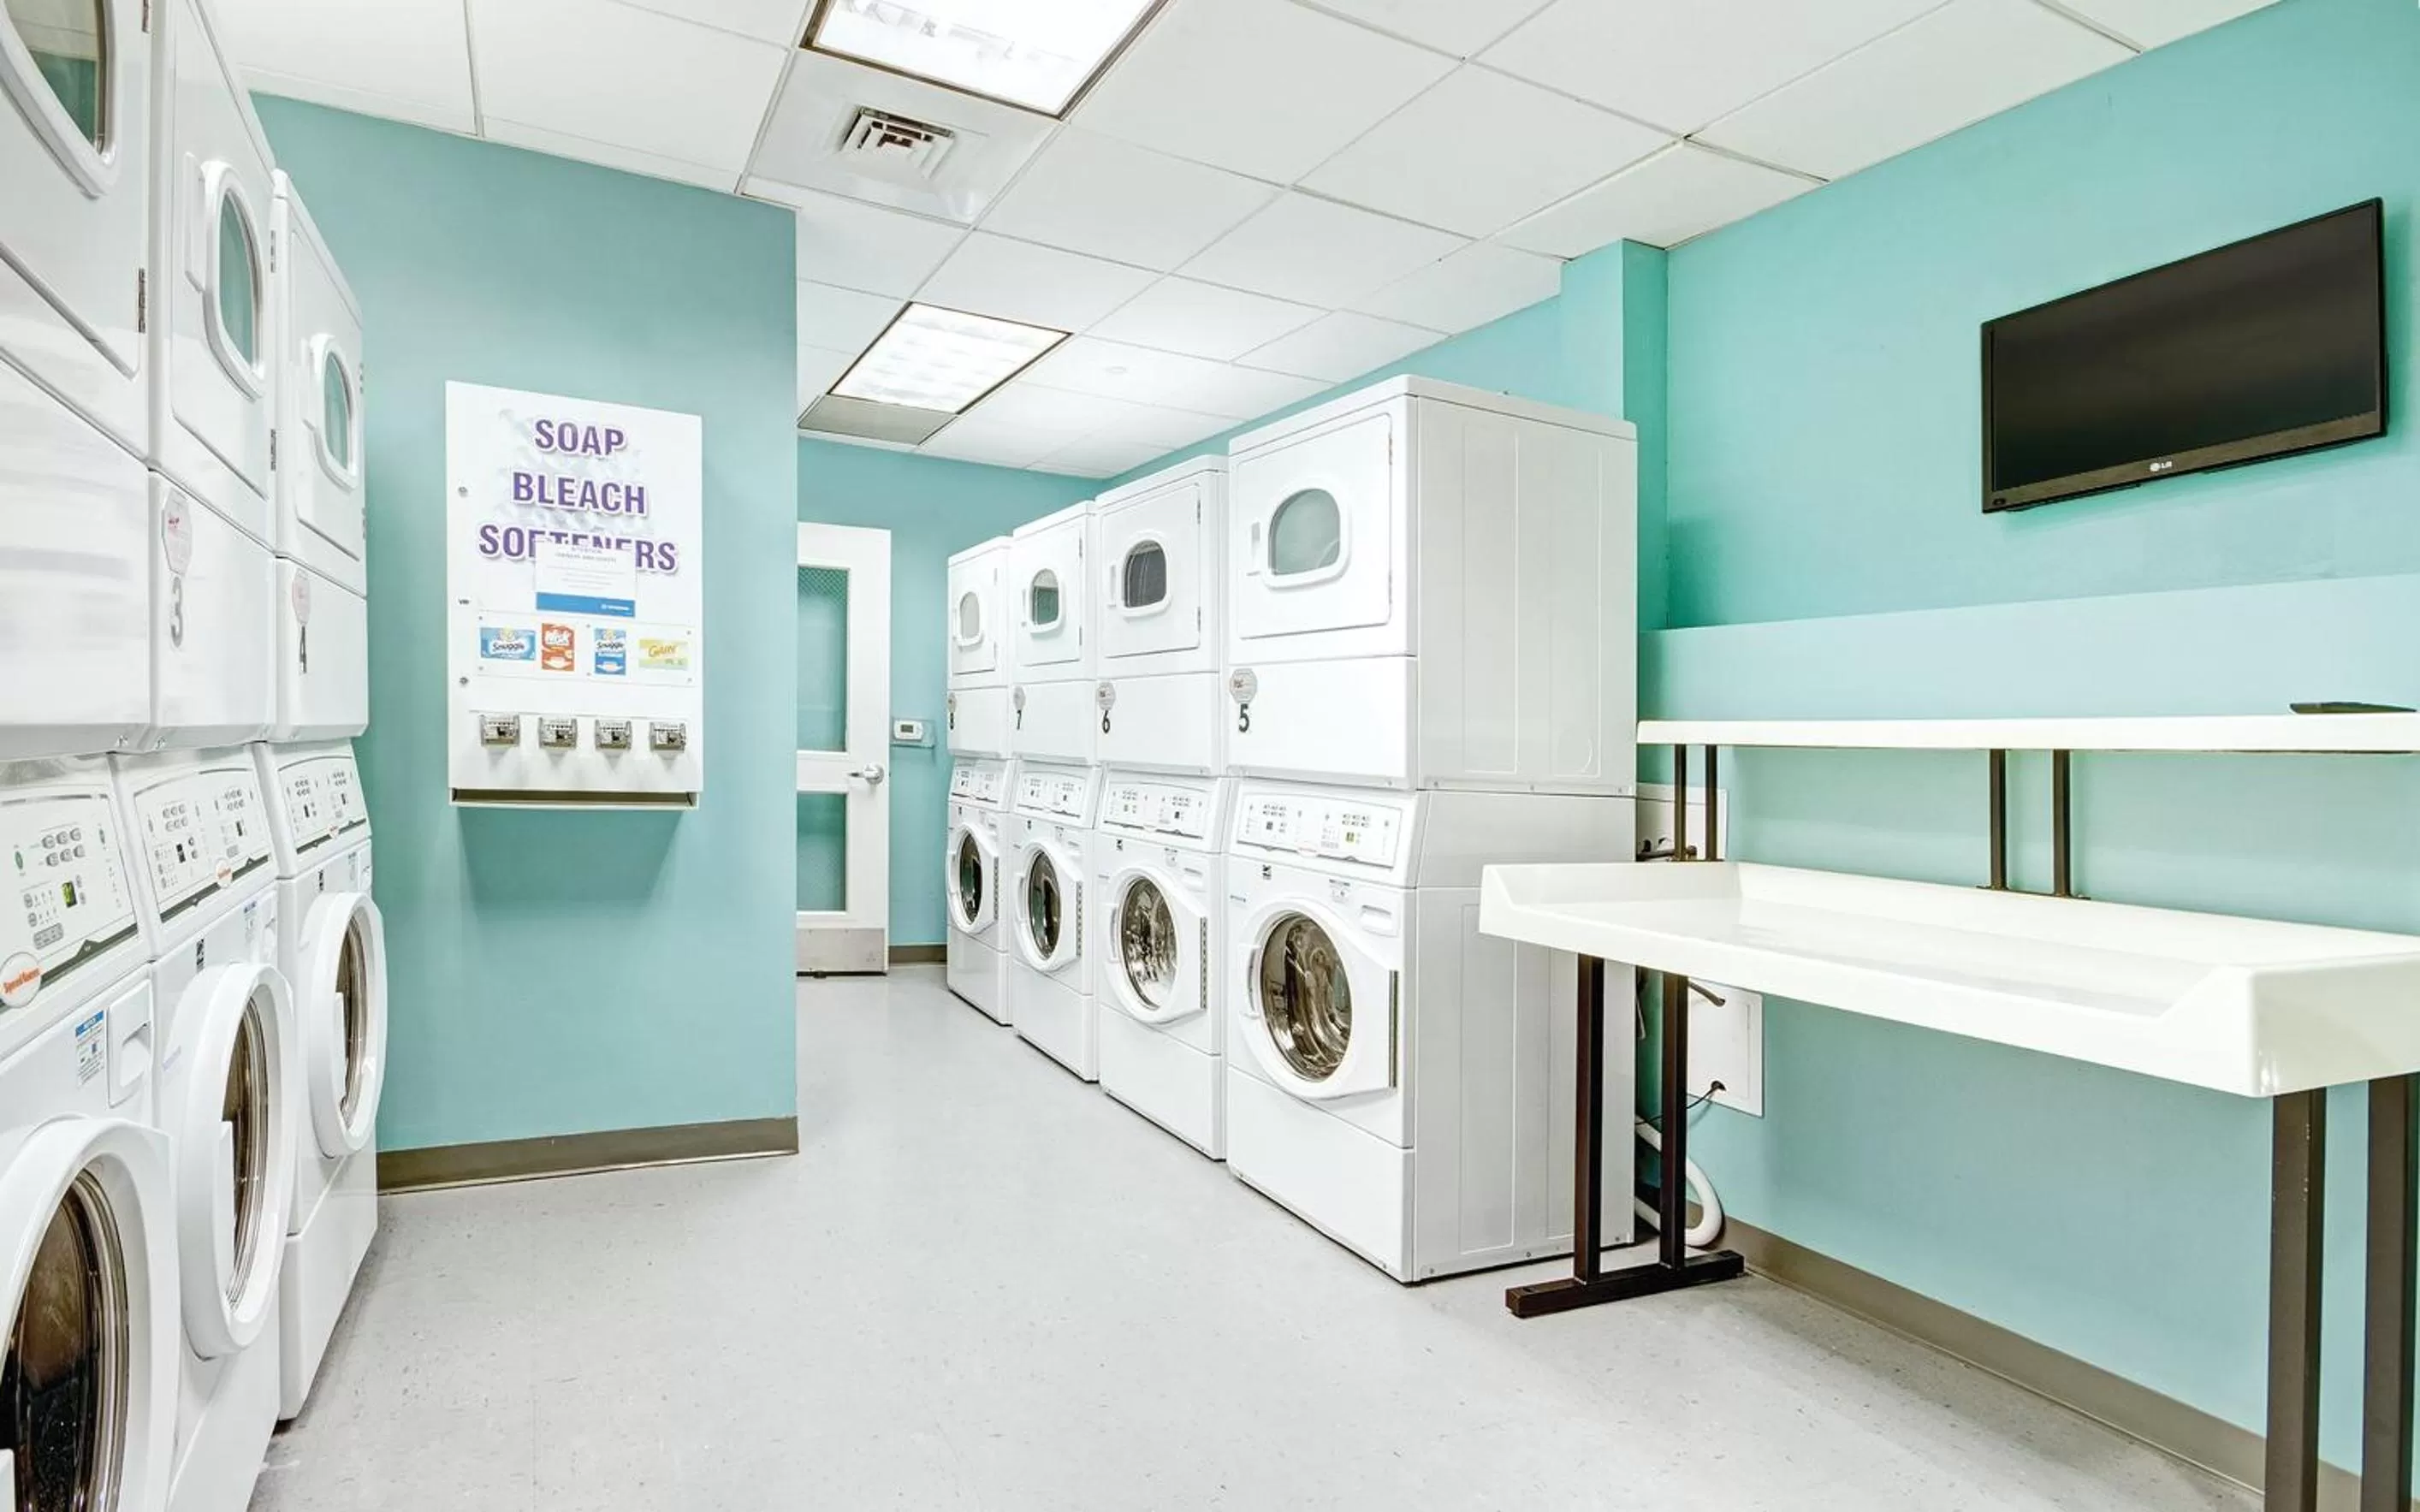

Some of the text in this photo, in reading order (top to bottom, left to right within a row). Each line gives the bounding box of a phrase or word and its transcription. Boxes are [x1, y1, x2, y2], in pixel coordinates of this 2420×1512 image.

[534, 418, 625, 455] SOAP
[513, 471, 644, 514] BLEACH
[171, 577, 183, 648] 3
[1017, 709, 1022, 730] 7
[1102, 709, 1111, 734] 6
[1238, 703, 1250, 733] 5
